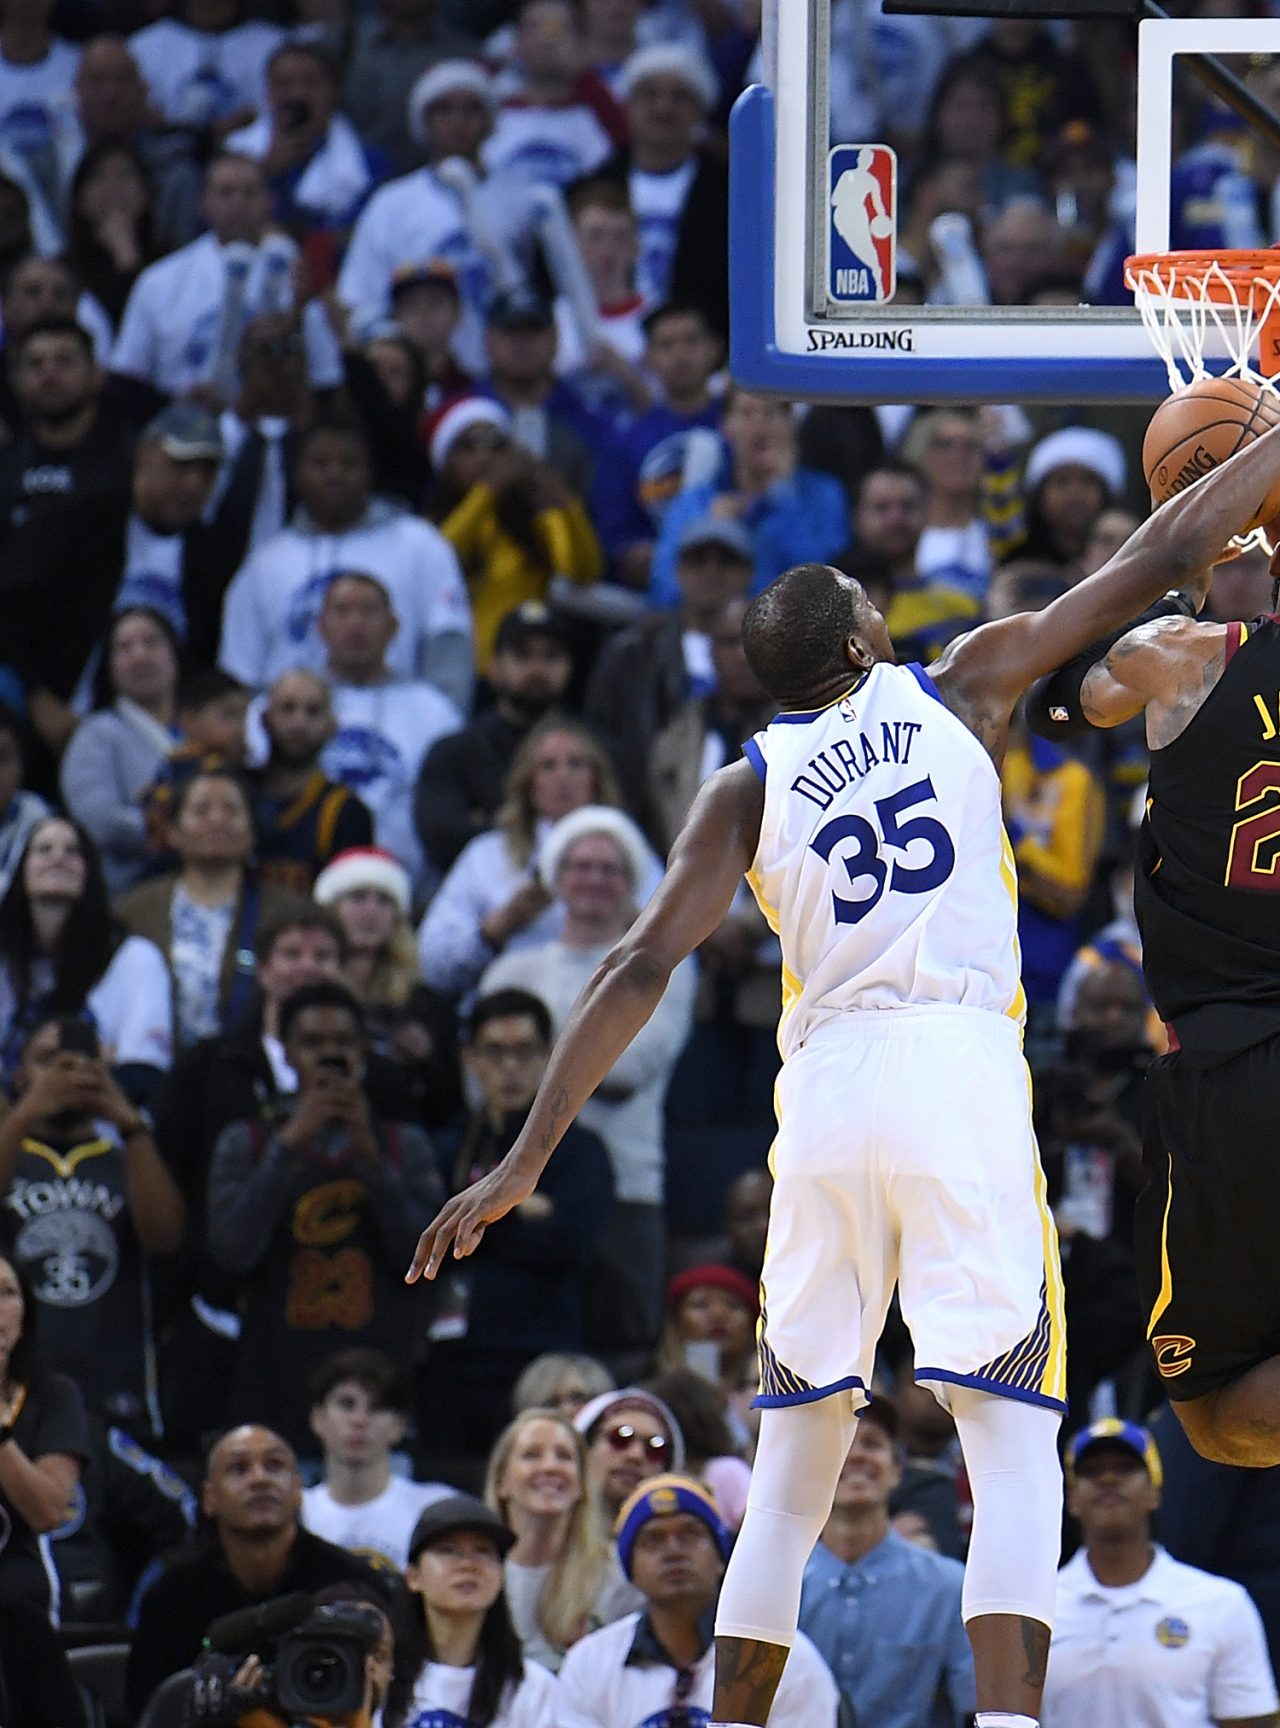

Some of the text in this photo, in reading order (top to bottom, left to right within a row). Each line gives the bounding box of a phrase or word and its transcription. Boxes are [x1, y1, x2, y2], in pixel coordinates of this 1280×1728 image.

[836, 268, 870, 295] NBA
[806, 328, 914, 353] SPALDING
[790, 721, 923, 812] DURANT
[808, 773, 956, 926] 35
[7, 1176, 124, 1219] TOWN
